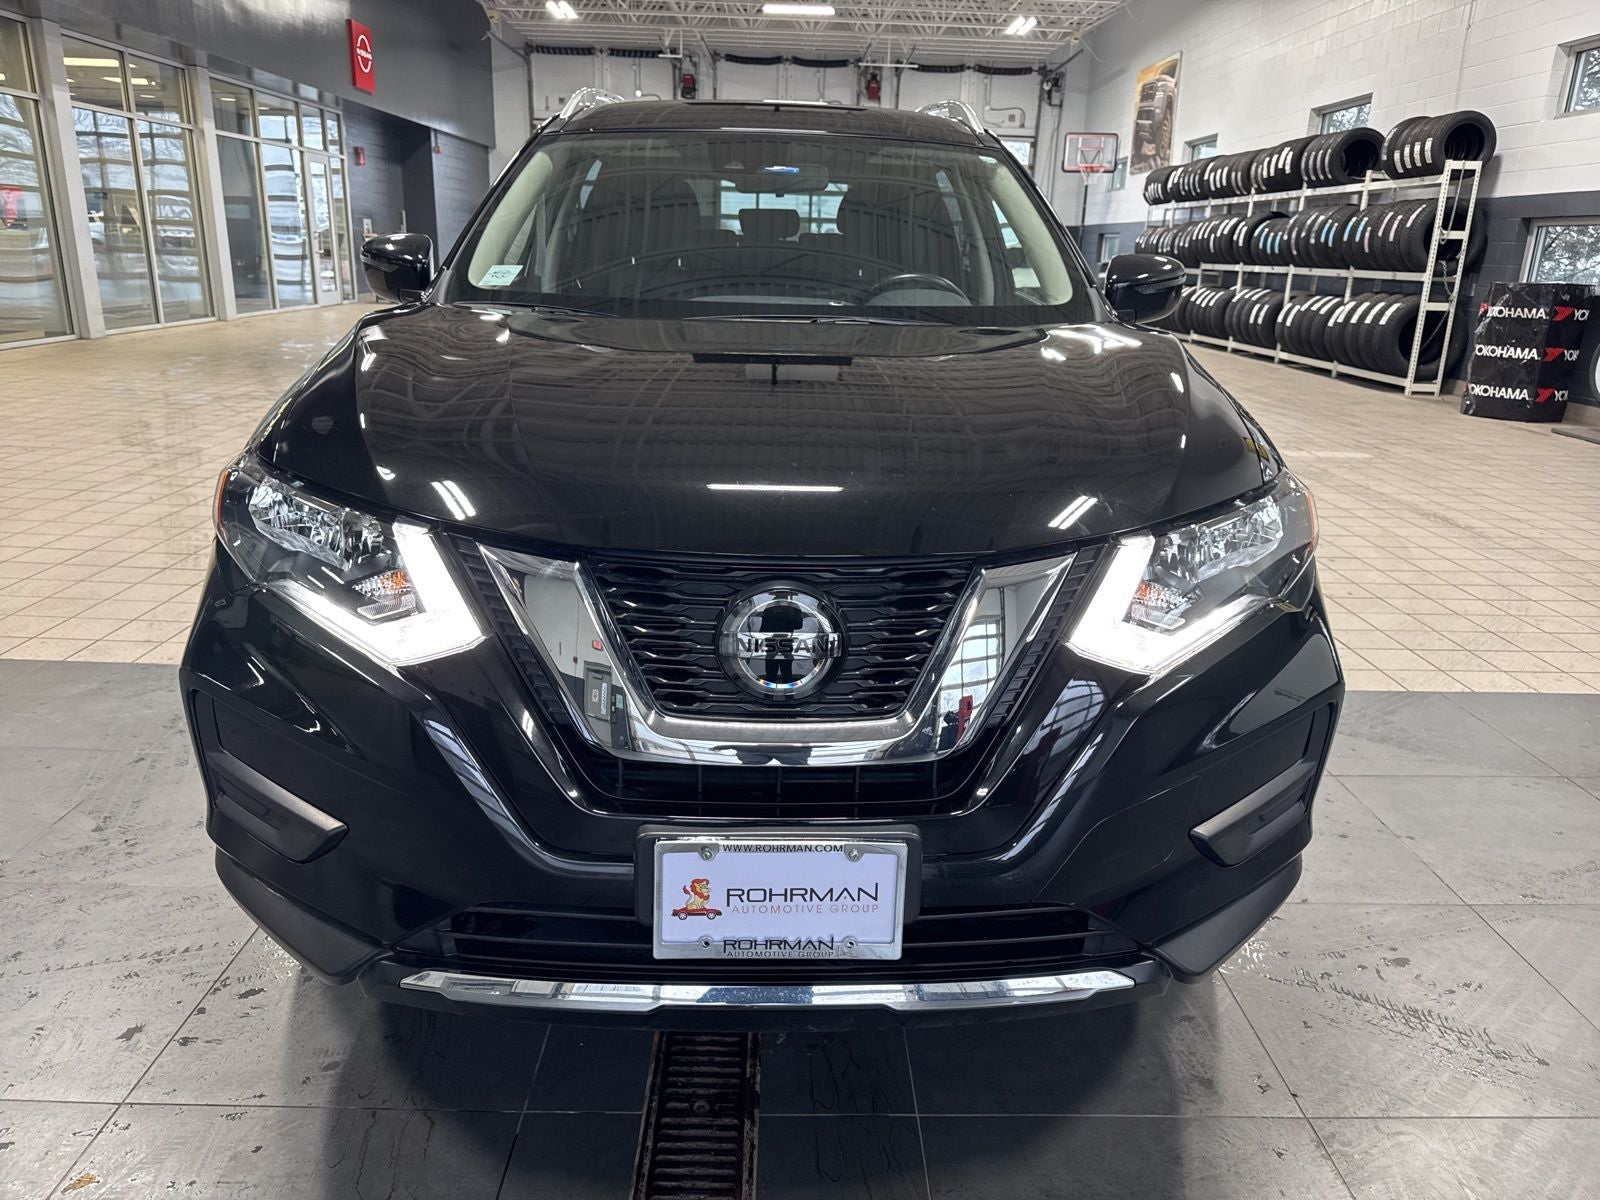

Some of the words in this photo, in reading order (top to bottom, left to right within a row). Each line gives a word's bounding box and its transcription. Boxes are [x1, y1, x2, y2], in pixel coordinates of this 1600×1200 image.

[738, 637, 829, 654] NISSAN
[722, 844, 843, 853] WWW.ROHRMAN.COM
[726, 882, 879, 907] ROHRMAN
[731, 904, 823, 914] AUTOMOTIVE
[829, 904, 879, 914] GROUP
[723, 936, 834, 953] ROHRMAN
[726, 950, 794, 959] AUTOMOTIVE
[797, 950, 834, 959] GROUP
